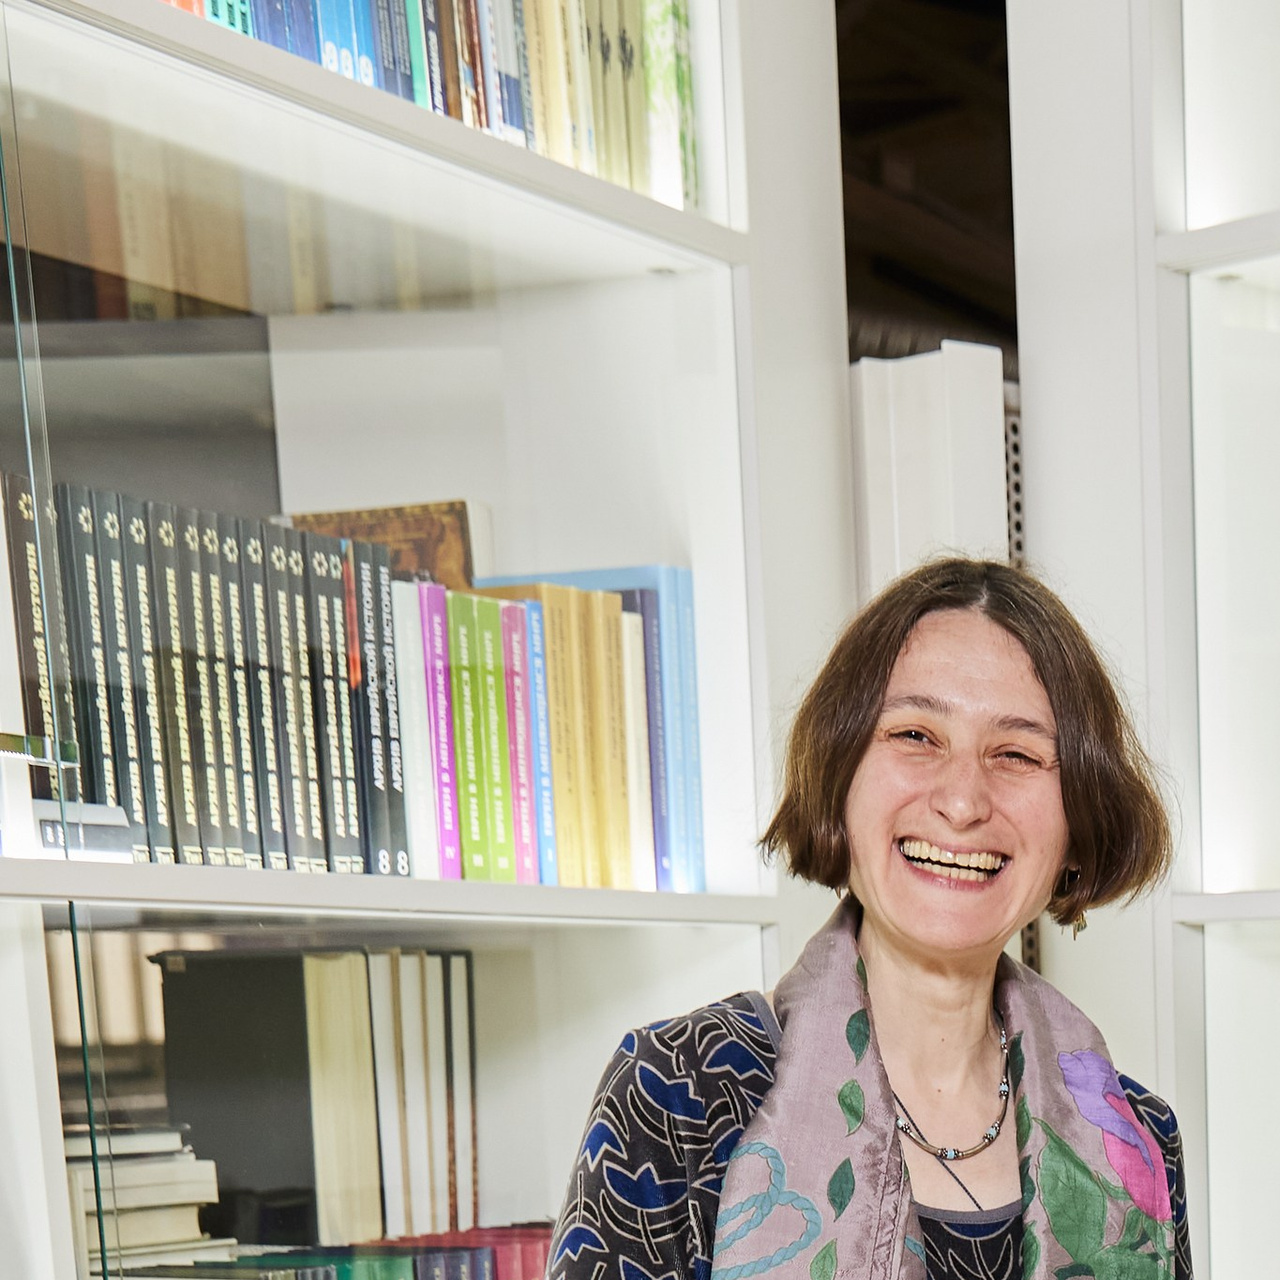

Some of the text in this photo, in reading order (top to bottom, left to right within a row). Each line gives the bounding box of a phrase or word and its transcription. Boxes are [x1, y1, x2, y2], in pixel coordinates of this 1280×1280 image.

[111, 559, 127, 647] ИСТОРИИ
[136, 565, 153, 652] ИСТОРИИ
[165, 566, 182, 653] ИСТОРИИ
[191, 571, 206, 656] ИСТОРИИ
[360, 563, 374, 640] ИСТОРИИ
[380, 566, 393, 643] ИСТОРИИ
[318, 595, 333, 675] ИСТОРИИ
[129, 761, 144, 824] АРХИВ
[182, 765, 196, 825] АРХИВ
[372, 738, 384, 790] АРХИВ
[390, 741, 403, 792] АРХИВ
[154, 765, 168, 826] АРХИВ
[206, 767, 220, 827] АРХИВ
[333, 780, 345, 837] АРХИВ
[379, 849, 390, 873] 8
[397, 851, 408, 875] 8
